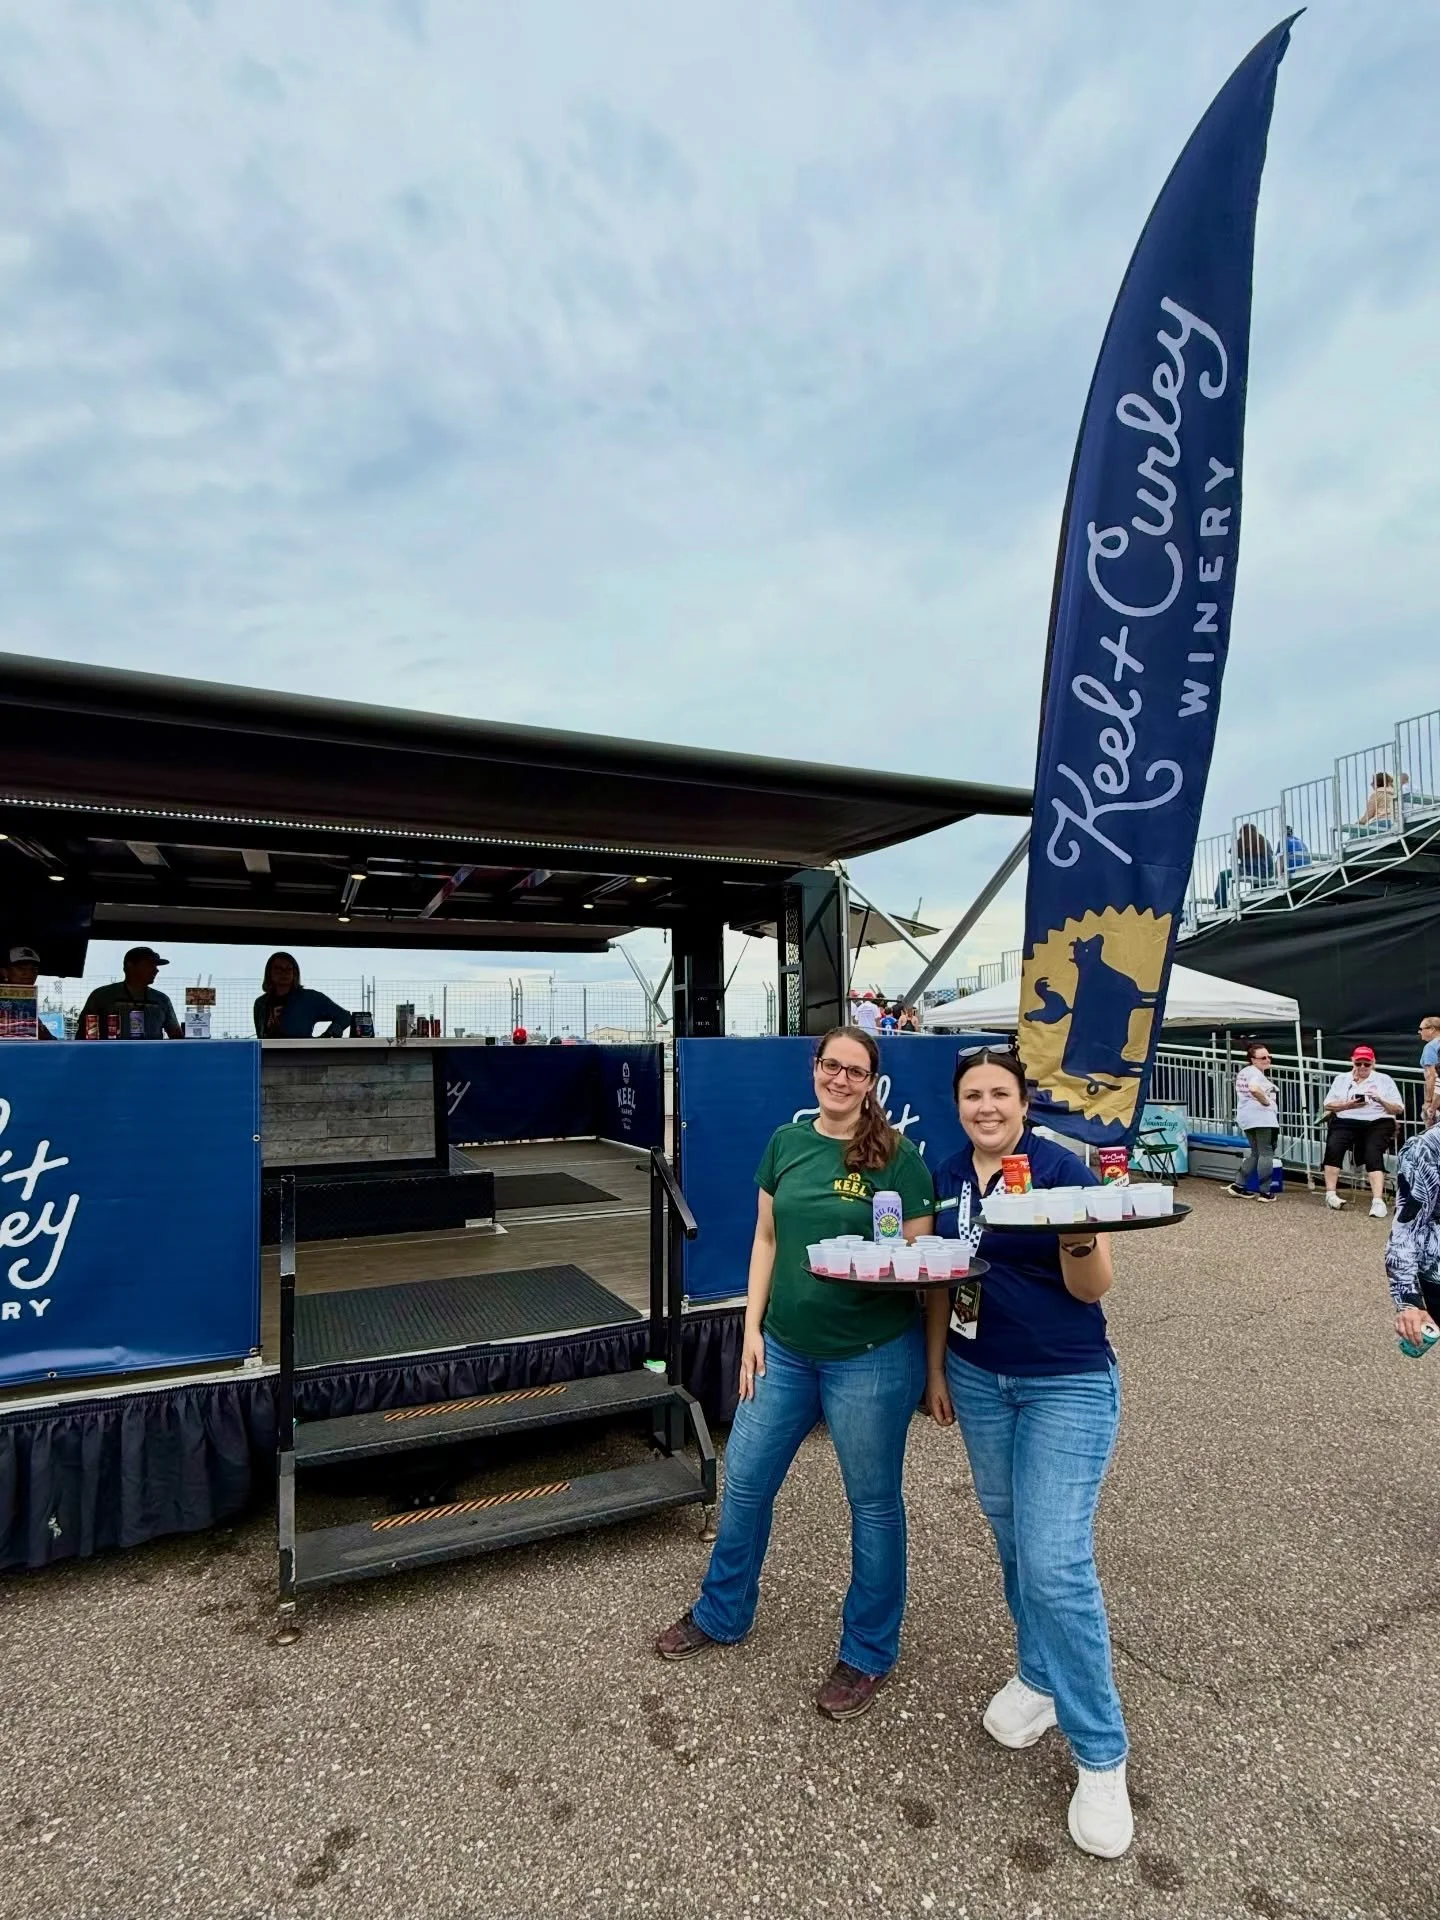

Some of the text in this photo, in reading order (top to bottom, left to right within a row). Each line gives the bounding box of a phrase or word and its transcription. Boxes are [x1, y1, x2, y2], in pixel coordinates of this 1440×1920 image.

[1087, 296, 1228, 617] Curley
[1178, 457, 1234, 717] WINERY
[1047, 674, 1184, 868] Keel
[617, 1087, 636, 1109] KEEL
[833, 1179, 867, 1197] KEEL
